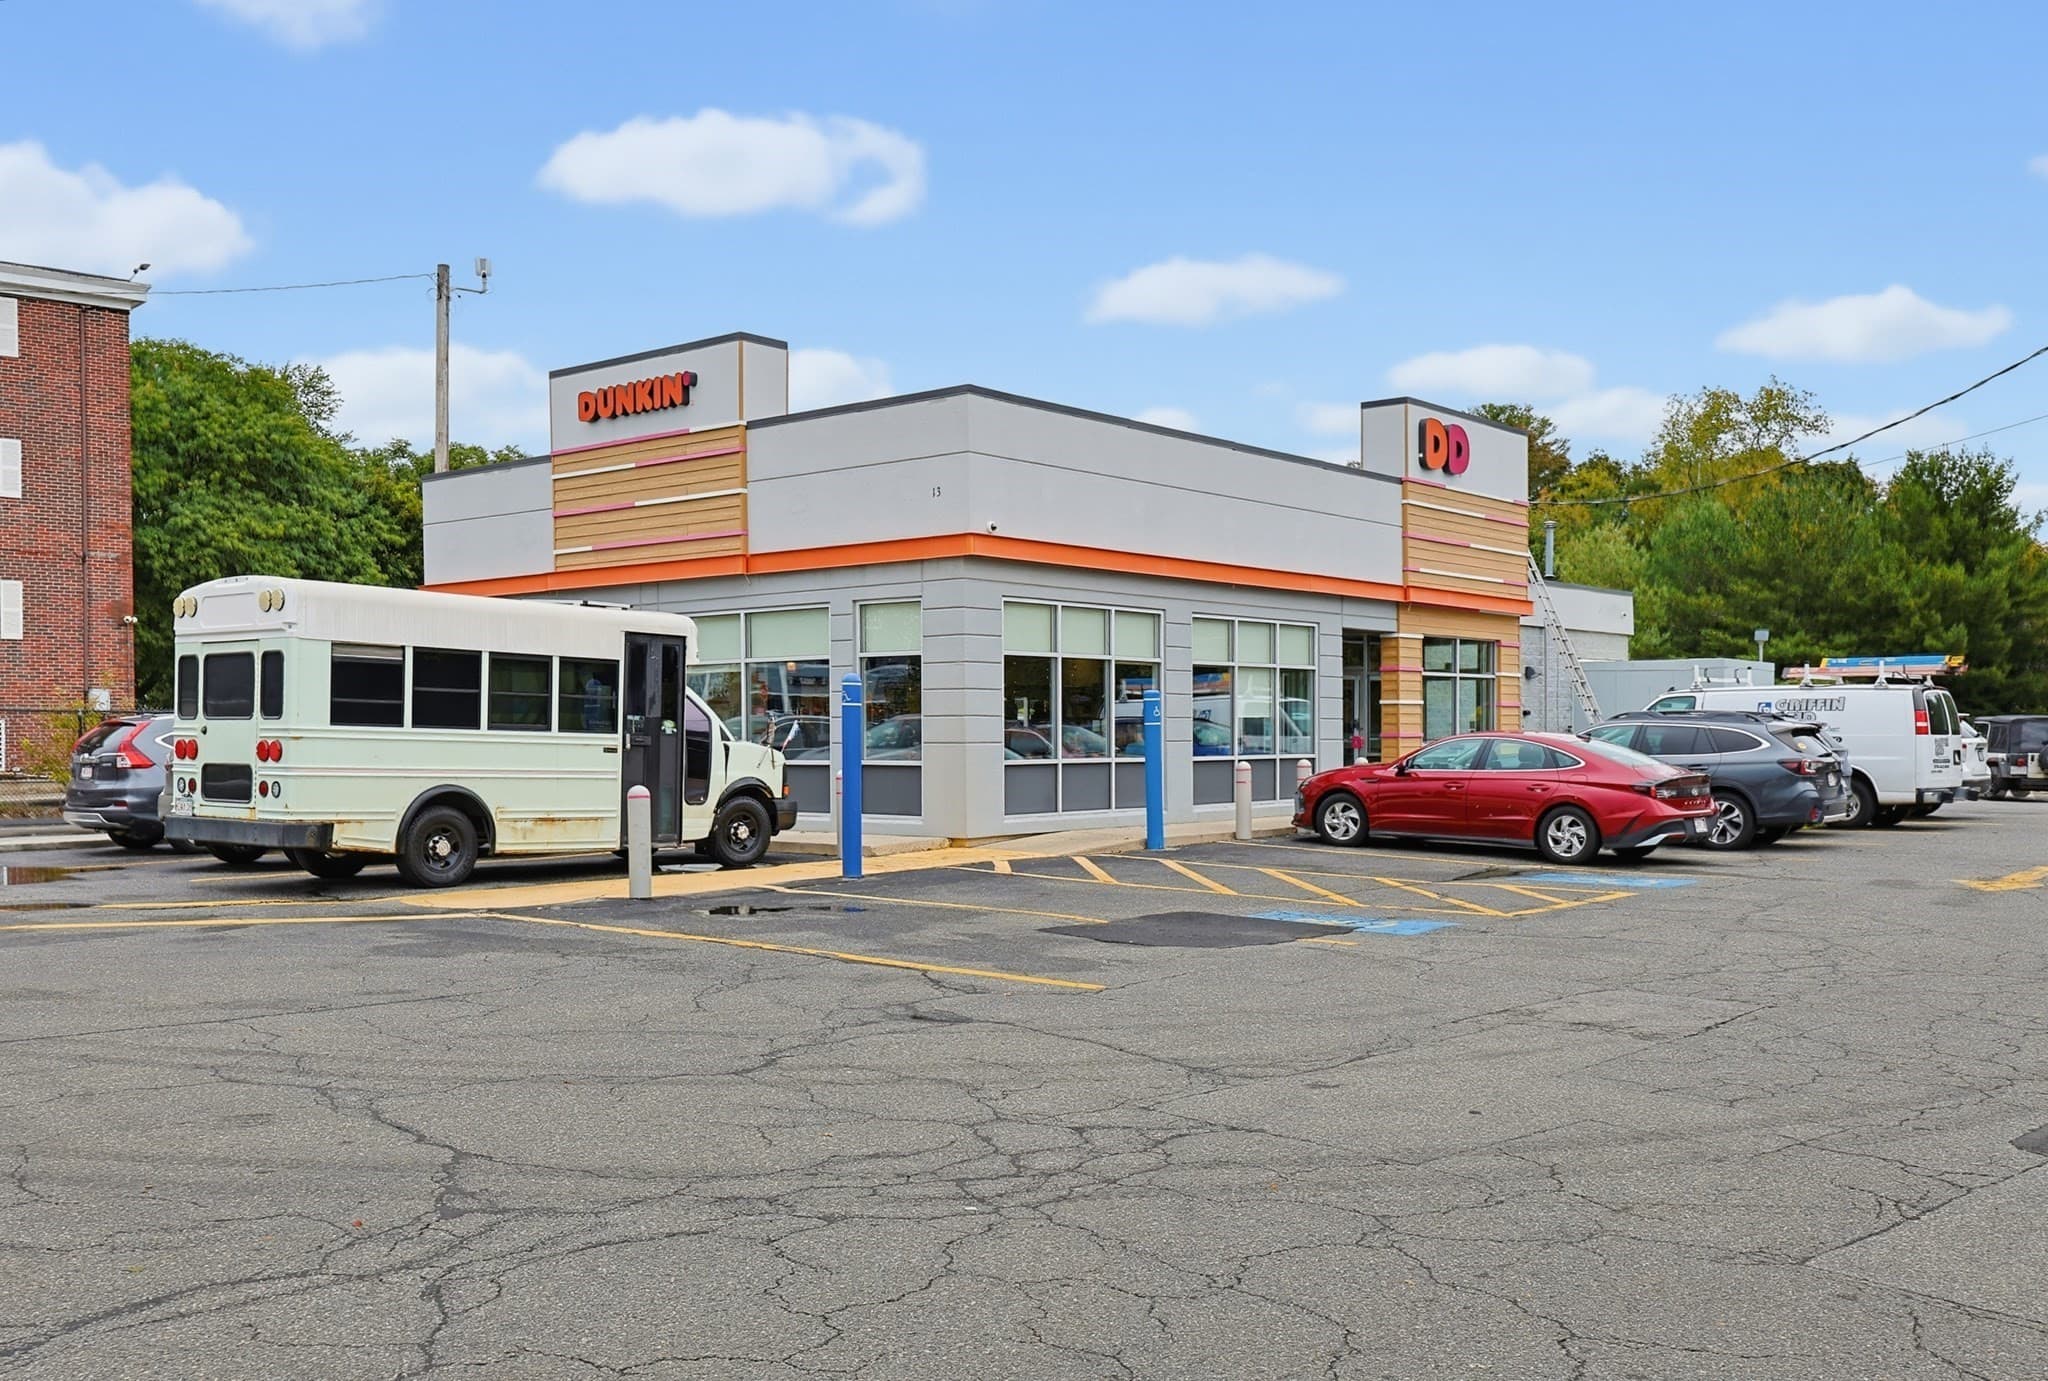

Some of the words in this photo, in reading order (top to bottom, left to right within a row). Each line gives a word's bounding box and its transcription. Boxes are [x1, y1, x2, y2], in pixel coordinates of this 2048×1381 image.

[577, 371, 697, 423] DUNKIN'
[1418, 417, 1470, 475] DD
[931, 486, 942, 498] 13
[1774, 696, 1846, 712] GRIFFIN
